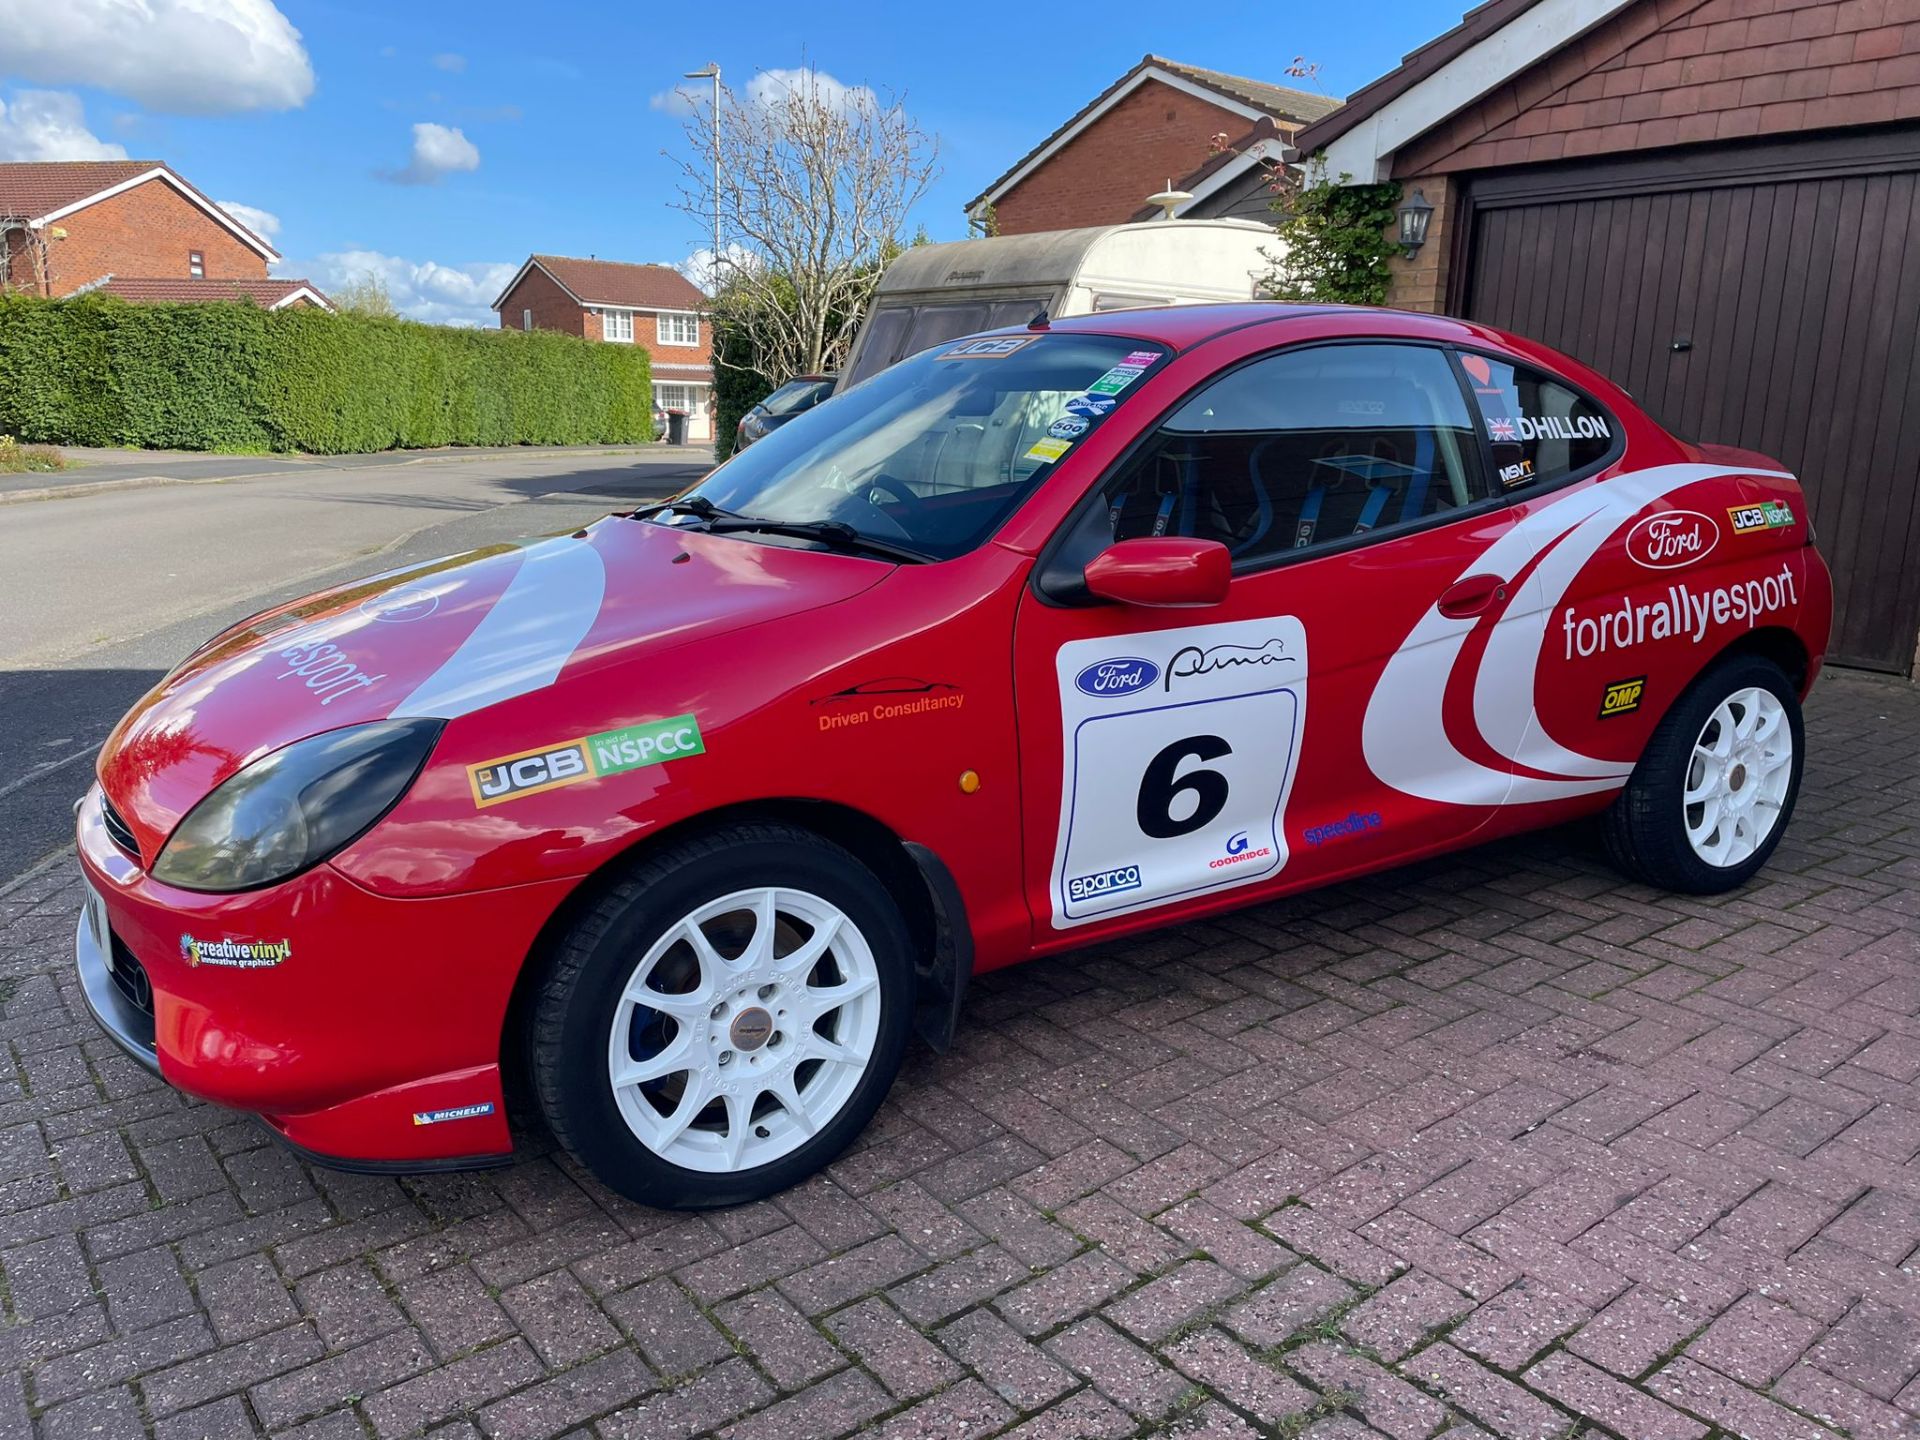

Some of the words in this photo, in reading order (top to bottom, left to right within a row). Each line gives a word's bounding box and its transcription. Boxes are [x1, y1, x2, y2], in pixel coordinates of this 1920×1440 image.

[949, 339, 1027, 355] JCB
[1053, 422, 1083, 433] 500
[1516, 416, 1611, 440] DHILLON
[1735, 509, 1765, 528] JCB
[1648, 517, 1702, 560] Ford
[1563, 562, 1797, 660] fordrallyesport
[1094, 663, 1143, 690] Ford
[1604, 685, 1642, 709] OMP
[819, 711, 869, 731] Driven
[873, 694, 964, 720] Consultancy
[597, 728, 696, 770] NSPCC
[482, 748, 585, 797] JCB
[1137, 734, 1233, 839] 6
[1304, 811, 1382, 846] speedline
[1209, 847, 1270, 869] GOODRIDGE
[1071, 867, 1138, 898] sparco
[201, 957, 237, 966] innovative
[239, 958, 275, 968] graphics
[434, 1104, 489, 1120] MICHELIN
